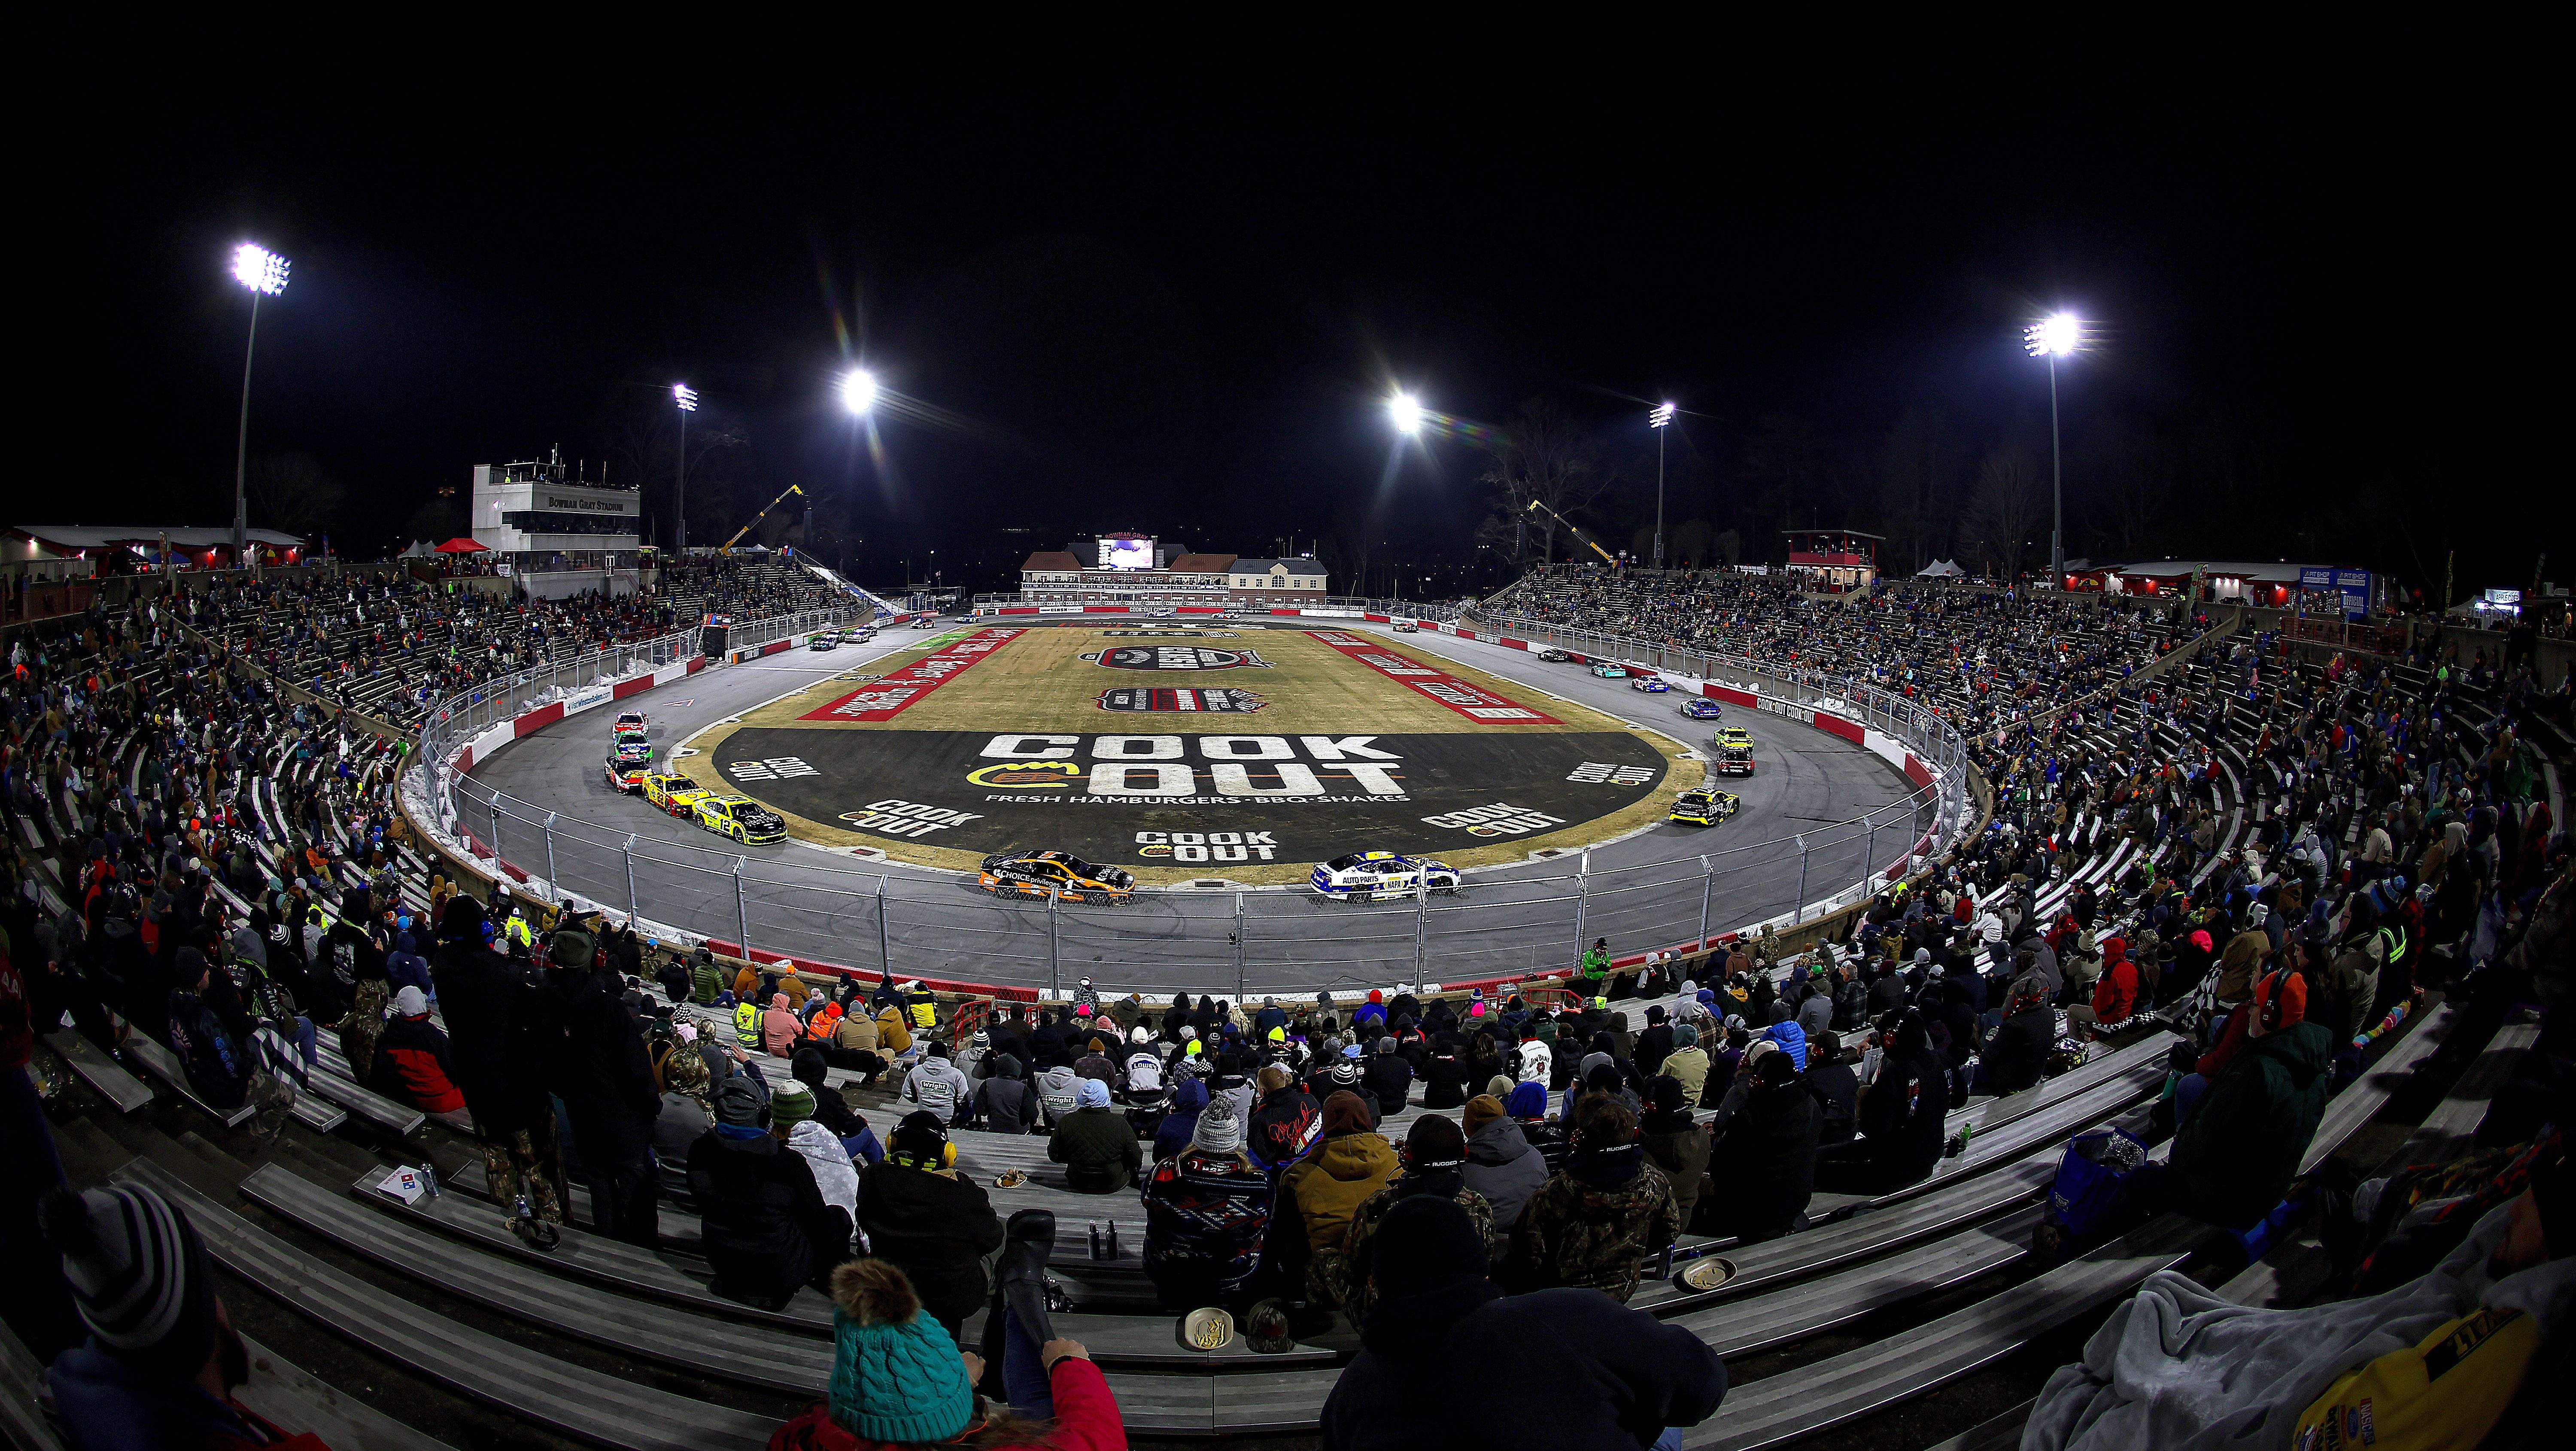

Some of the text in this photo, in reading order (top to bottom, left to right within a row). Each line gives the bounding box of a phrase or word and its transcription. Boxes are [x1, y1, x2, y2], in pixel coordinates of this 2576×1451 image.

[549, 497, 623, 511] BOWMAN GRAY STADIUM
[2343, 595, 2364, 607] OFFICIAL
[1158, 647, 1200, 668] CLASH
[1410, 681, 1483, 705] GRIZZLY
[1757, 697, 1815, 724] COOK OUT COOK OUT
[979, 735, 1404, 759] COOK
[729, 765, 779, 782] OUT
[762, 756, 821, 779] COOK
[1566, 761, 1618, 783] COOK
[1087, 763, 1406, 796] OUT
[657, 792, 664, 804] 22
[1069, 795, 1241, 805] HAMBURGERS
[1256, 795, 1307, 804] BBQ
[1725, 799, 1734, 814] 77
[696, 804, 719, 819] MENARDS
[865, 799, 985, 826] COOK
[1421, 802, 1533, 829] COOK
[720, 819, 730, 833] 12
[853, 811, 950, 838] OUT
[1490, 811, 1567, 834] OUT
[1135, 831, 1277, 844] COOK
[1175, 844, 1277, 862] OUT
[1000, 870, 1030, 882] CHOICE
[1030, 876, 1061, 888] privileges.
[1062, 879, 1074, 895] 1
[1360, 875, 1379, 883] PARTS
[1387, 880, 1401, 889] NAPA
[1134, 1062, 1157, 1071] LOWE'S
[1529, 1056, 1539, 1068] JIM
[923, 1081, 947, 1090] Wright
[1303, 1112, 1322, 1142] NASCA
[2361, 1402, 2374, 1443] NASCAR
